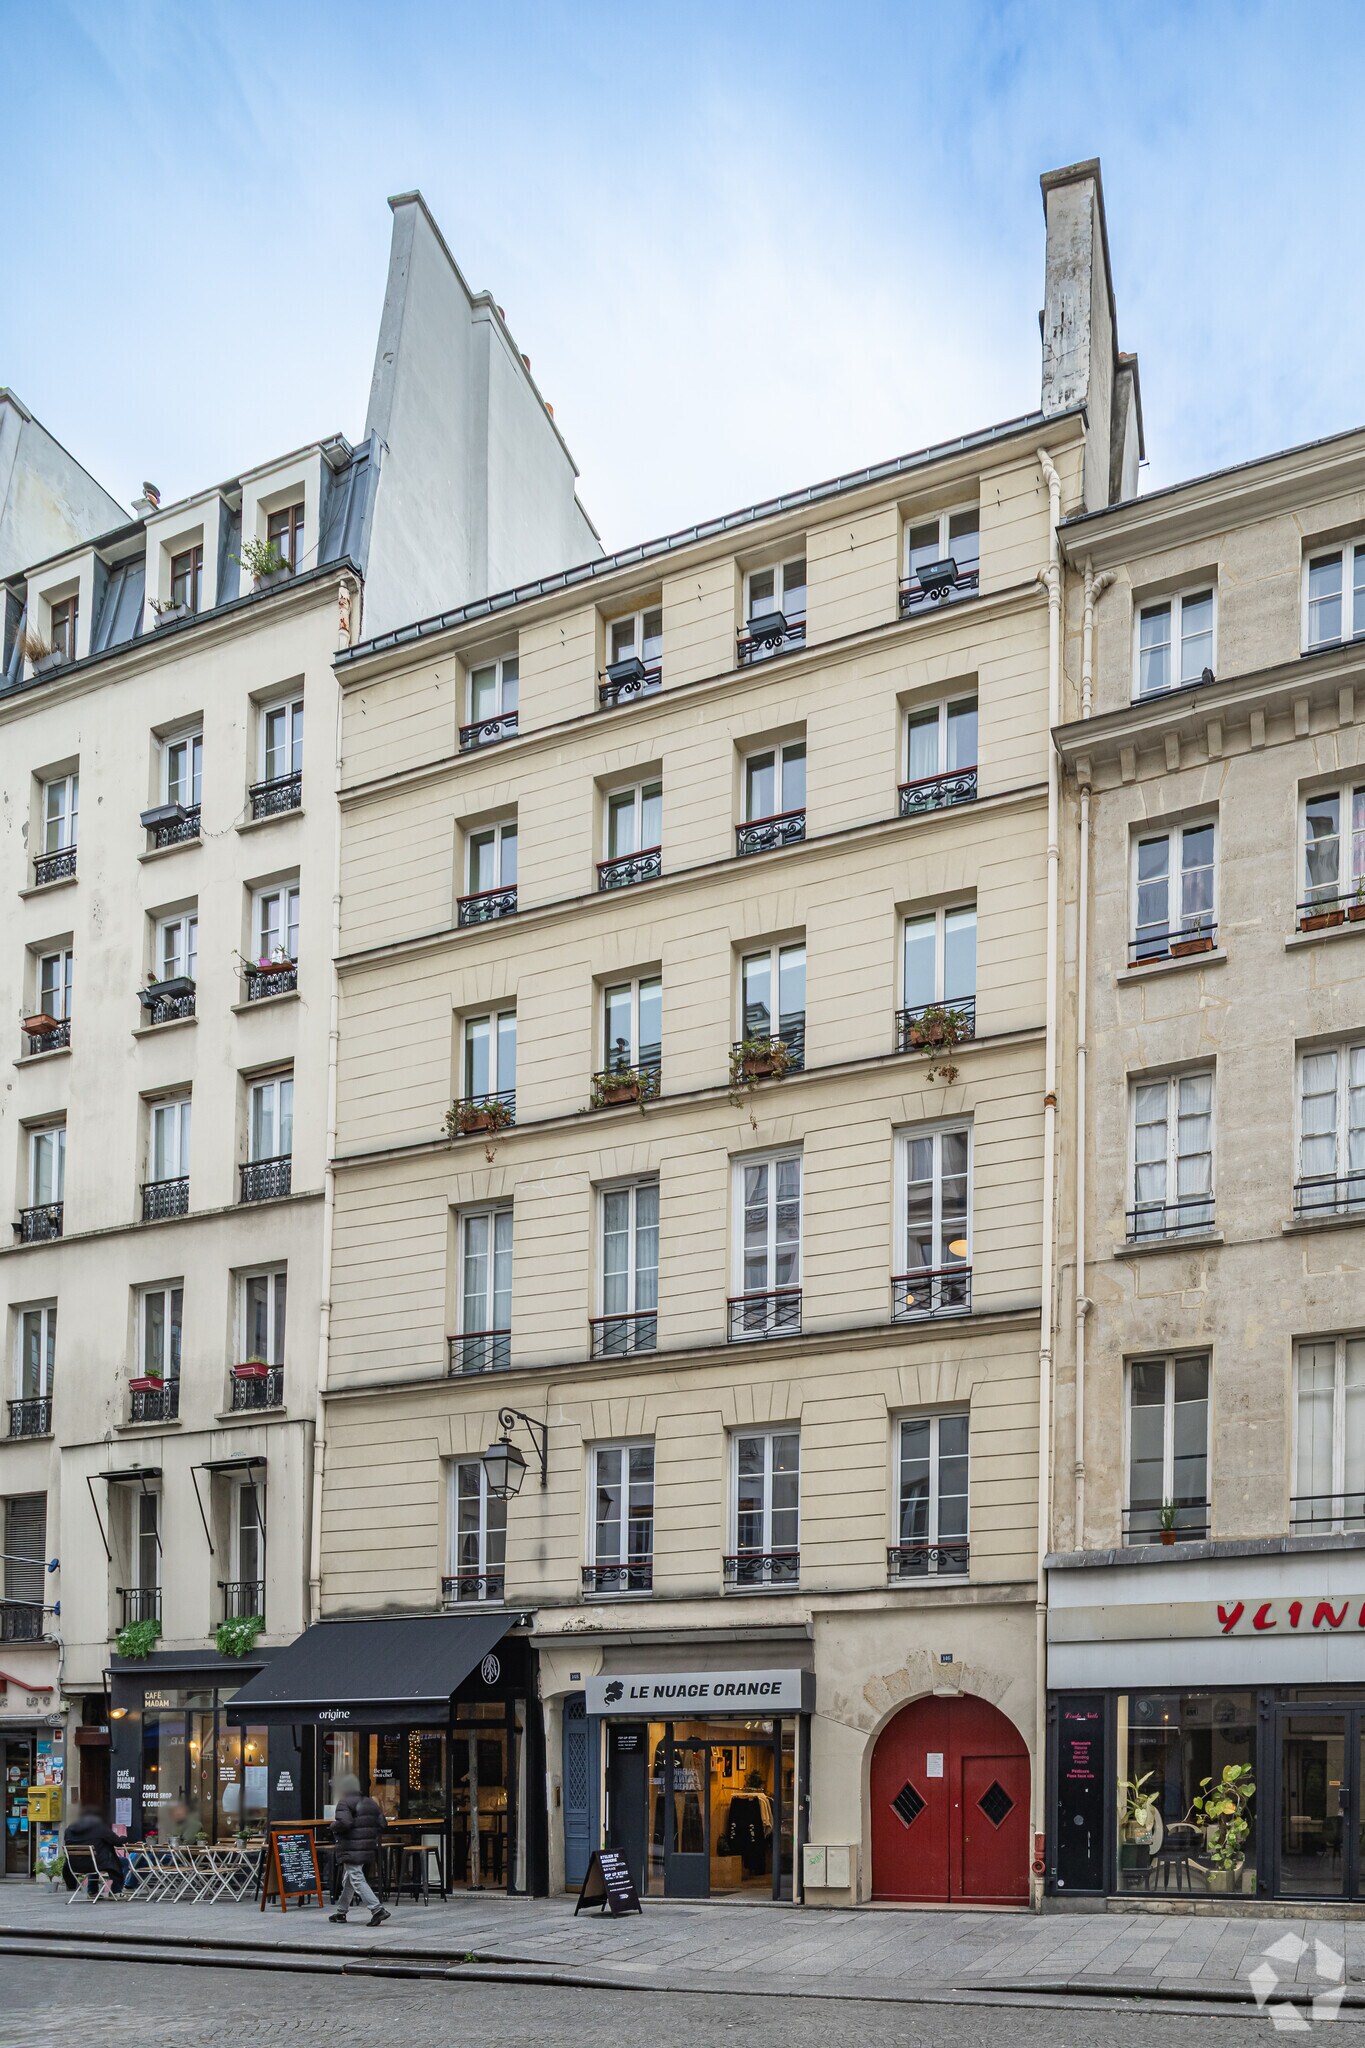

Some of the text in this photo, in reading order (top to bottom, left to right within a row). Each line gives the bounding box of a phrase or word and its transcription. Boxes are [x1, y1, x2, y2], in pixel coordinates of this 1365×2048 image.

[144, 1691, 161, 1699] CAFÉ
[630, 1682, 782, 1698] LE NUAGE ORANGE
[319, 1709, 350, 1721] origine
[117, 1769, 129, 1777] CAFÉ
